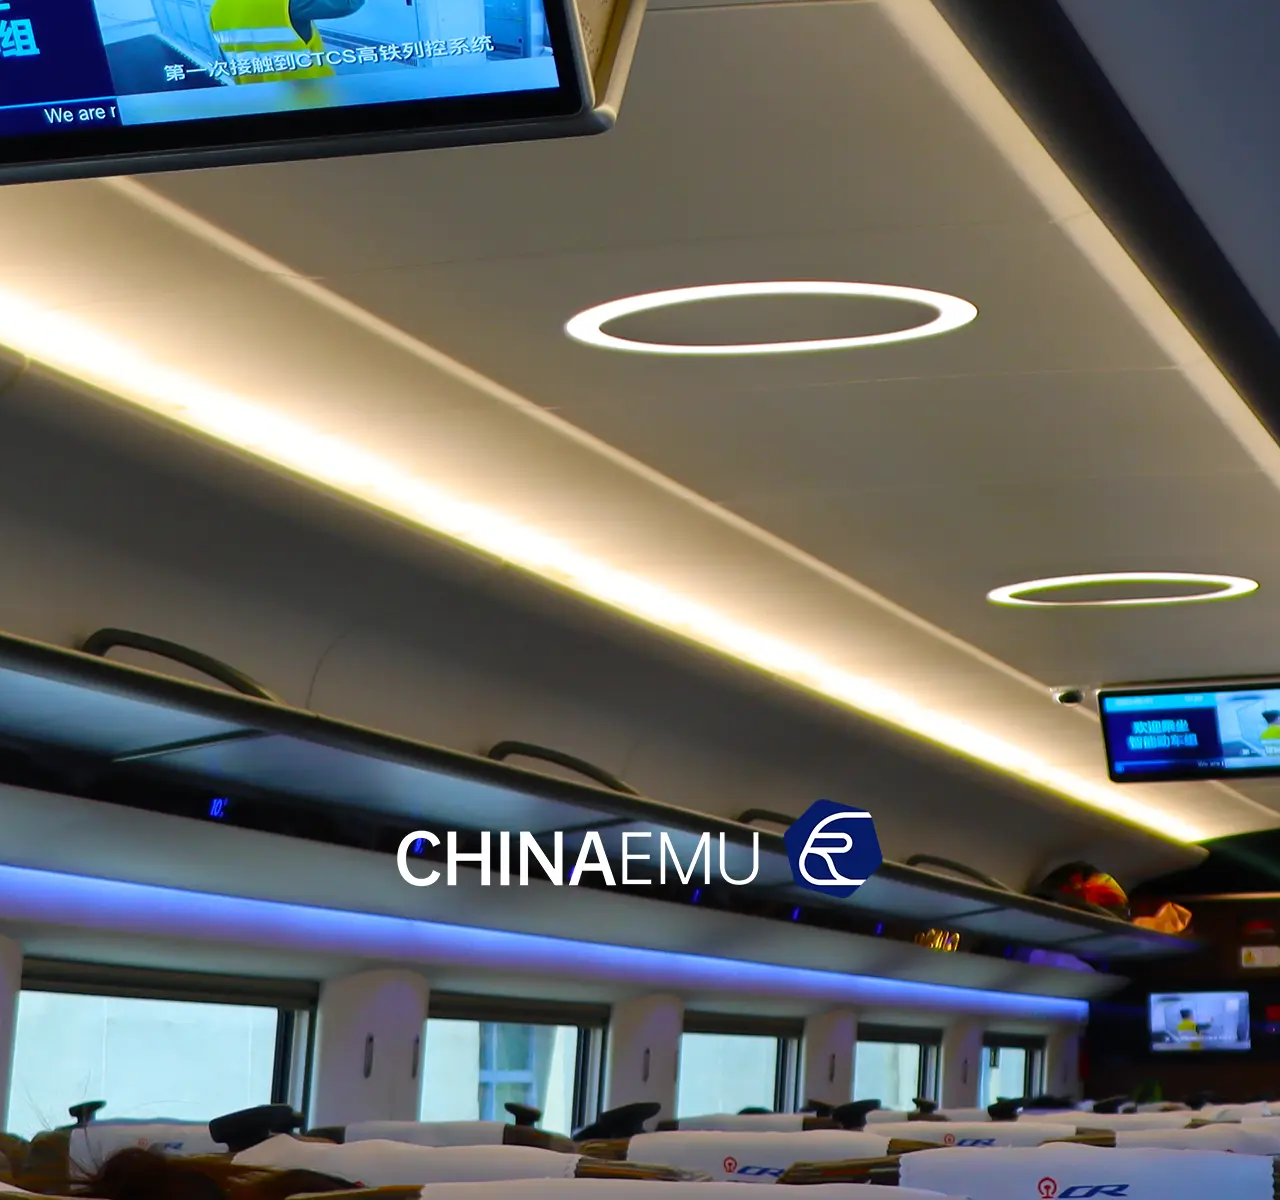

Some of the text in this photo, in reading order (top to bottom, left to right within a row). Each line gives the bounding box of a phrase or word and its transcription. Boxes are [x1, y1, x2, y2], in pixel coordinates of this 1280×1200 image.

[163, 34, 496, 83] 第一次接触到CTCS高铁列控系统
[43, 106, 74, 124] We
[78, 105, 107, 121] are
[1058, 1183, 1130, 1199] CR
